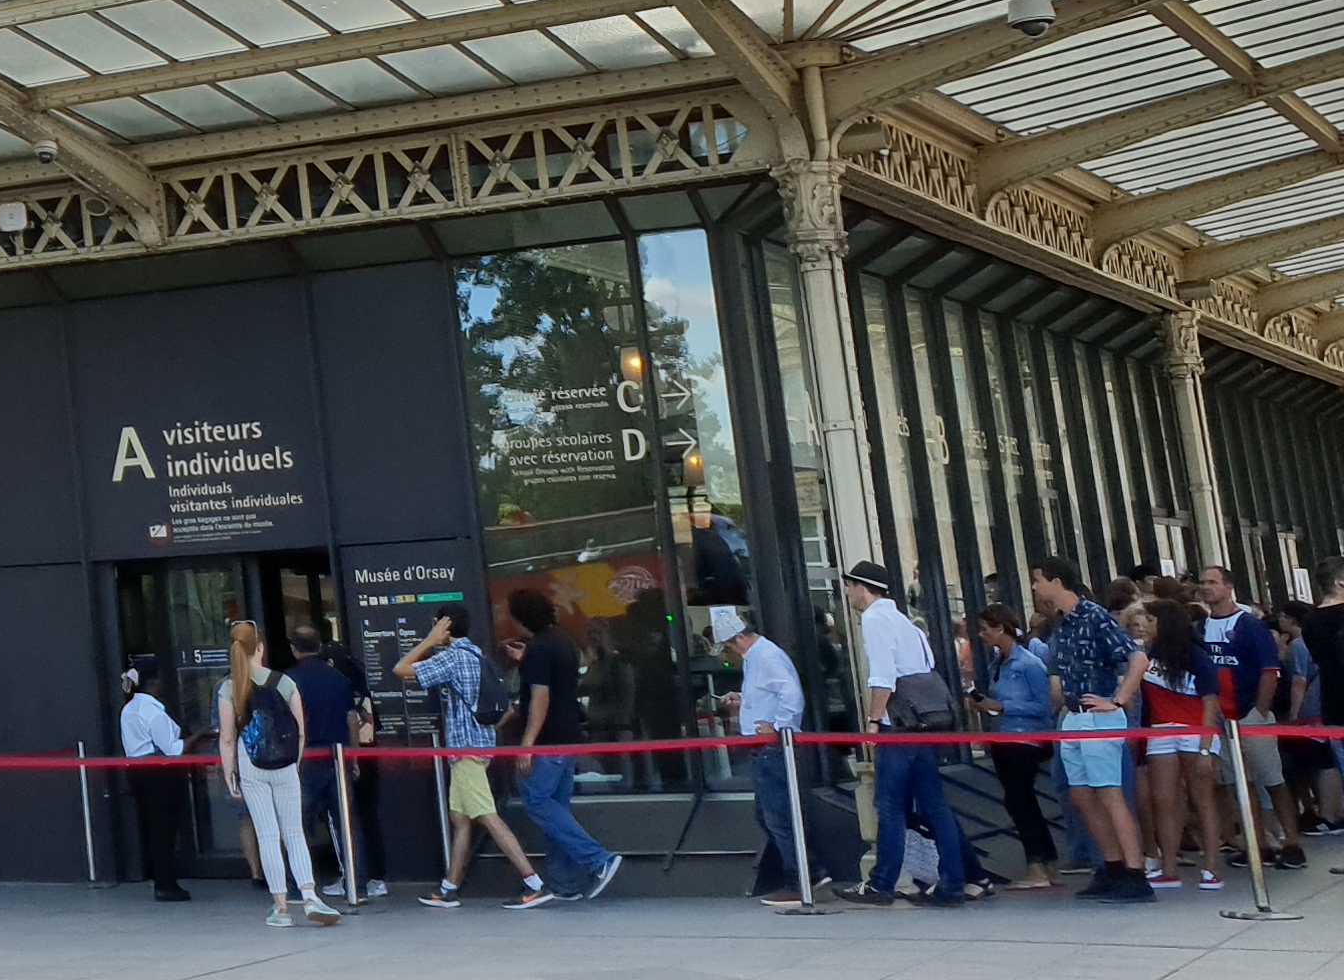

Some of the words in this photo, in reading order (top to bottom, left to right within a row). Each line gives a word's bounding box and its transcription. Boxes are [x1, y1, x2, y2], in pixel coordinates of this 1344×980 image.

[551, 383, 607, 400] réservée
[616, 380, 642, 414] C
[163, 421, 262, 446] visiteurs
[556, 431, 613, 446] scolaires
[622, 428, 647, 461] D
[112, 426, 156, 482] A
[167, 446, 293, 477] individuels
[509, 454, 538, 466] avec
[542, 448, 614, 465] réservation
[169, 482, 232, 498] Individuals
[170, 500, 228, 513] visitantes
[232, 493, 303, 509] individuales
[355, 567, 400, 583] Musée
[403, 565, 456, 581] d'Orsay
